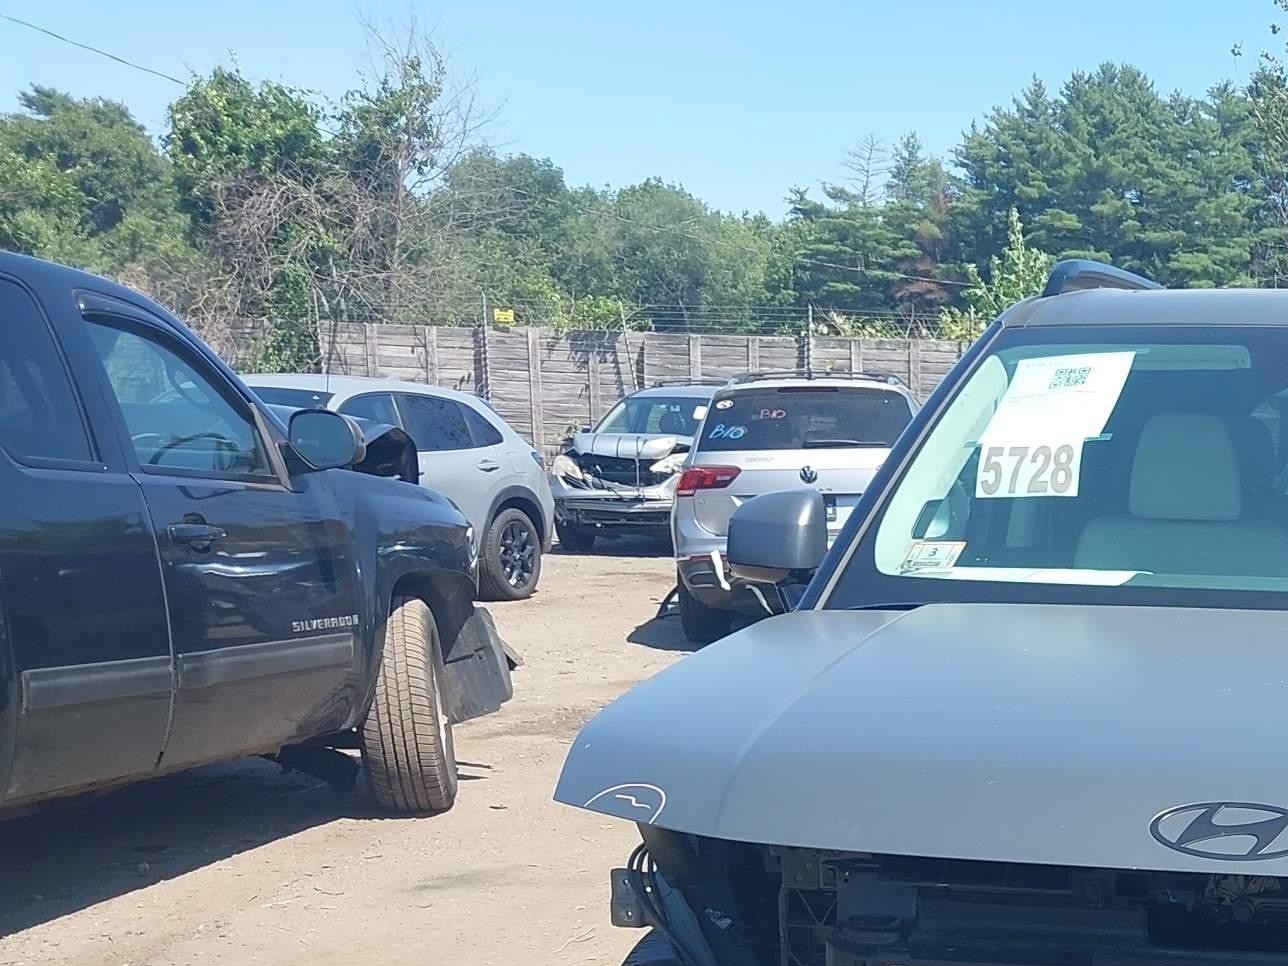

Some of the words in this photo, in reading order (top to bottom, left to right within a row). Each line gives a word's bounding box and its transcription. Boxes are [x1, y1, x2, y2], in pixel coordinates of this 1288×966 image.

[980, 444, 1074, 496] 5728
[928, 547, 939, 557] 3
[291, 614, 353, 632] SILVERADO
